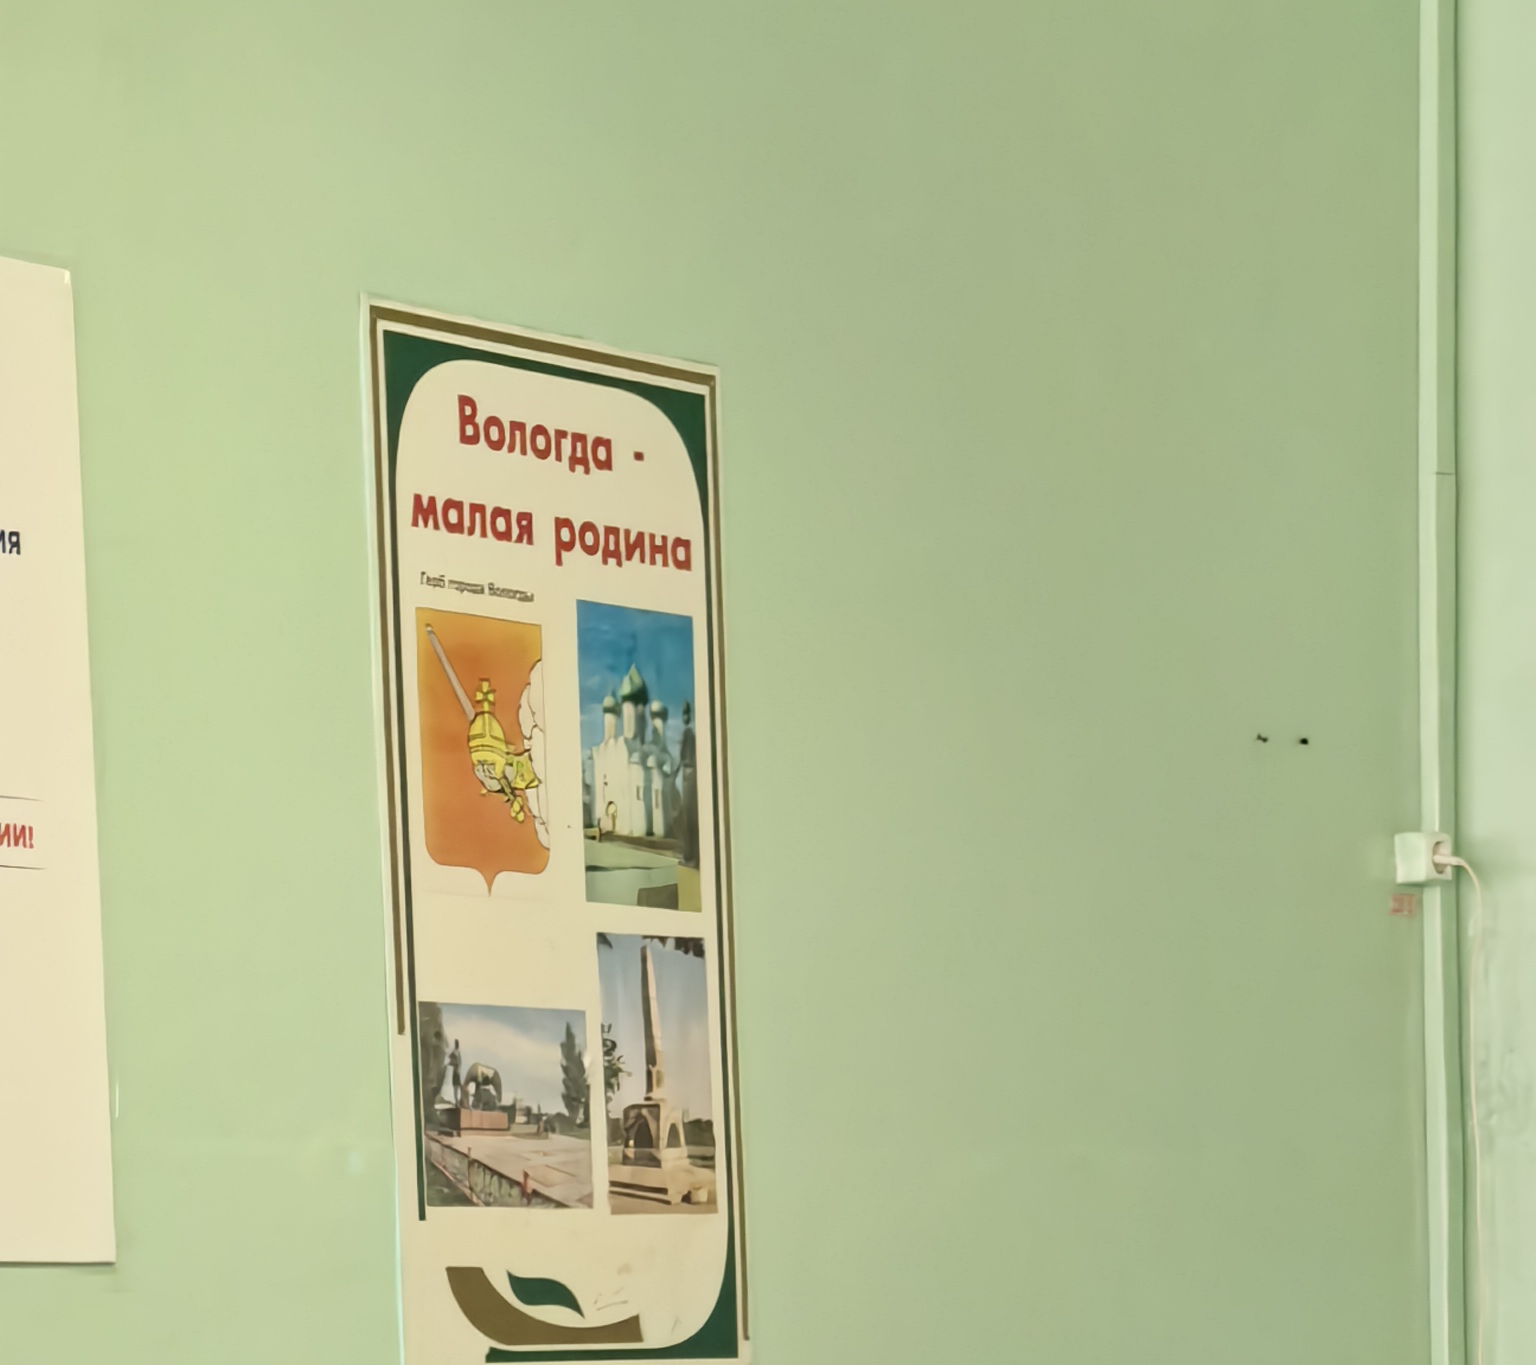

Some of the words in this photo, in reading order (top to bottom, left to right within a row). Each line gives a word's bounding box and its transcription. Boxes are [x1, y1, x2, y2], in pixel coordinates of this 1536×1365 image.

[457, 394, 613, 475] Вологда
[411, 493, 534, 545] малая
[554, 516, 692, 571] родина
